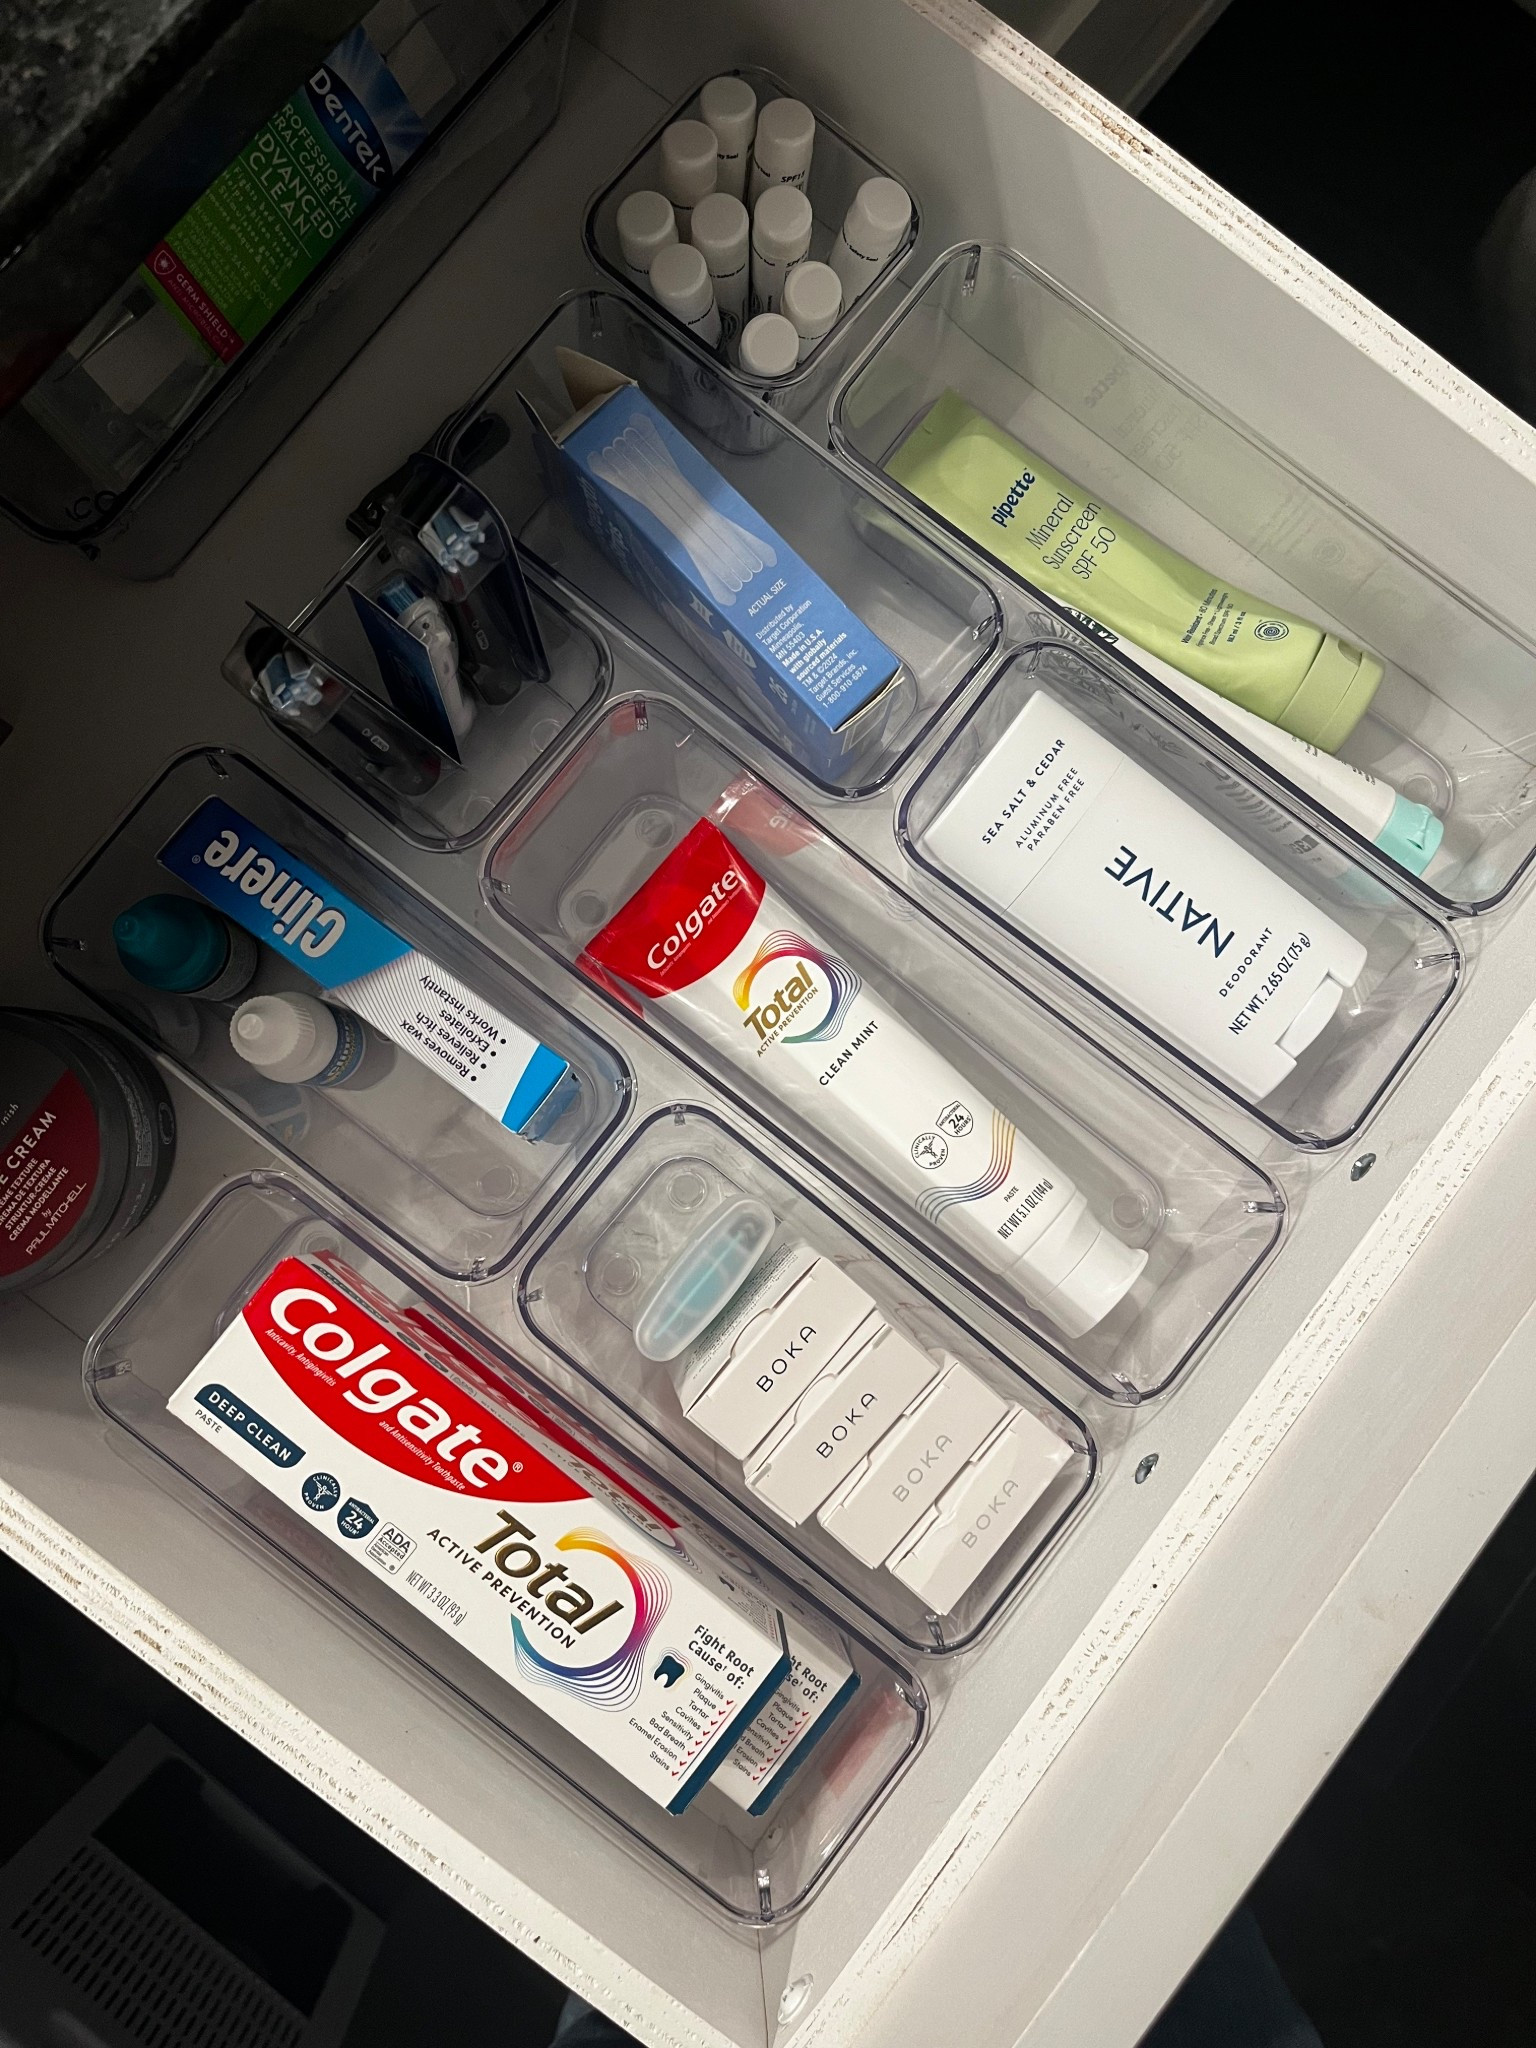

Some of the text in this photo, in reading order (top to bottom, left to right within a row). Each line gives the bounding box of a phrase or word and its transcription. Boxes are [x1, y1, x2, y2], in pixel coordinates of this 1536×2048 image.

[308, 70, 387, 183] DenTek
[279, 101, 362, 216] ROFESSIONAL
[245, 148, 314, 237] CLEAN
[295, 149, 333, 197] CARE
[326, 195, 352, 224] KIT
[173, 271, 202, 304] GERM
[197, 301, 230, 340] SHIELD
[986, 466, 1040, 529] pipette
[1023, 489, 1075, 552] Mineral
[1040, 495, 1102, 572] Sunscreen
[1070, 548, 1101, 581] SPF
[1088, 522, 1119, 555] 50
[746, 577, 788, 617] ACTUAL SIZE
[754, 602, 795, 640] Distributed by
[761, 598, 814, 647] Target Corporation
[767, 619, 805, 654] Minneapolis,
[774, 630, 807, 661] MN 55403
[780, 625, 825, 668] Made in U.S.A.
[787, 636, 829, 675] with globally
[794, 630, 848, 682] sourced materials
[800, 674, 815, 688] TM
[810, 670, 819, 679] &
[807, 674, 830, 696] Target
[824, 655, 850, 680] Brands,
[814, 661, 857, 702] Guest Services
[820, 663, 870, 709] 1-800-910-6874
[980, 737, 1066, 845] SEA SALT & CEDAR
[1013, 765, 1079, 849] ALUMINUM FREE
[1026, 777, 1086, 852] PARABEN FREE
[645, 867, 741, 971] Colgate
[1103, 844, 1236, 959] NATIVE
[1217, 925, 1276, 998] DEODORANT
[1227, 930, 1314, 1036] NET WT. 2.65 OZ (75 g)
[416, 971, 501, 1041] Works instantly
[743, 960, 815, 1041] Total
[754, 985, 820, 1058] ACTIVE PREVENTION
[397, 1017, 471, 1078] Removes wax
[412, 1009, 481, 1066] Relieves itch
[435, 1007, 490, 1054] Exfoliates
[816, 1018, 881, 1088] CLEAN MINT
[3, 1108, 58, 1172] CREAM
[947, 1110, 965, 1130] 24
[914, 1134, 935, 1158] CLINICALLY
[928, 1148, 945, 1166] PROVEN
[9, 1156, 39, 1191] TEXTURE
[13, 1156, 52, 1202] DE TEXTURA
[1002, 1184, 1020, 1202] PASTE
[3, 1165, 58, 1231] STRUKTUR-CREME
[7, 1165, 70, 1242] CREMA MODELLANTE
[24, 1178, 88, 1256] PAUL MITCHELL
[40, 1205, 54, 1220] by
[996, 1182, 1050, 1240] NET WT 5.1 OZ (144
[263, 1325, 338, 1389] Anticavity, Antigingivitis
[753, 1322, 818, 1394] BOKA
[193, 1408, 223, 1434] PASTE
[206, 1389, 293, 1463] DEEP CLEAN
[814, 1388, 879, 1461] BOKA
[377, 1418, 466, 1493] and Antisensitivity Toothpaste
[890, 1431, 955, 1504] BOKA
[303, 1491, 324, 1510] PROVEN
[311, 1475, 337, 1498] CLINICALLY
[343, 1508, 368, 1531] 24
[957, 1476, 1023, 1550] BOKA
[375, 1535, 406, 1561] Accepted
[381, 1524, 414, 1554] ADA
[404, 1568, 461, 1623] NET WT 3.3 OZ (93
[425, 1524, 578, 1652] ACTIVE PREVENTION
[473, 1509, 625, 1636] Total
[691, 1622, 728, 1656] Fight
[723, 1648, 757, 1678] Root
[690, 1687, 719, 1712] Plaque
[692, 1671, 727, 1701] Gingivitis
[724, 1669, 747, 1690] of:
[799, 1666, 830, 1693] Root
[800, 1684, 821, 1704] of:
[647, 1716, 688, 1751] Bad Breath
[658, 1709, 696, 1742] Sensitivity
[673, 1705, 703, 1731] Cavities
[686, 1699, 711, 1721] Tartar
[754, 1717, 781, 1740] Cavities
[766, 1711, 788, 1731] Tartar
[770, 1700, 795, 1723] Plaque
[627, 1716, 680, 1761] Enamel Erosion
[647, 1749, 672, 1771] Stains
[735, 1746, 760, 1768] Erosion
[743, 1737, 767, 1759] Breath
[730, 1757, 754, 1778] Stains
